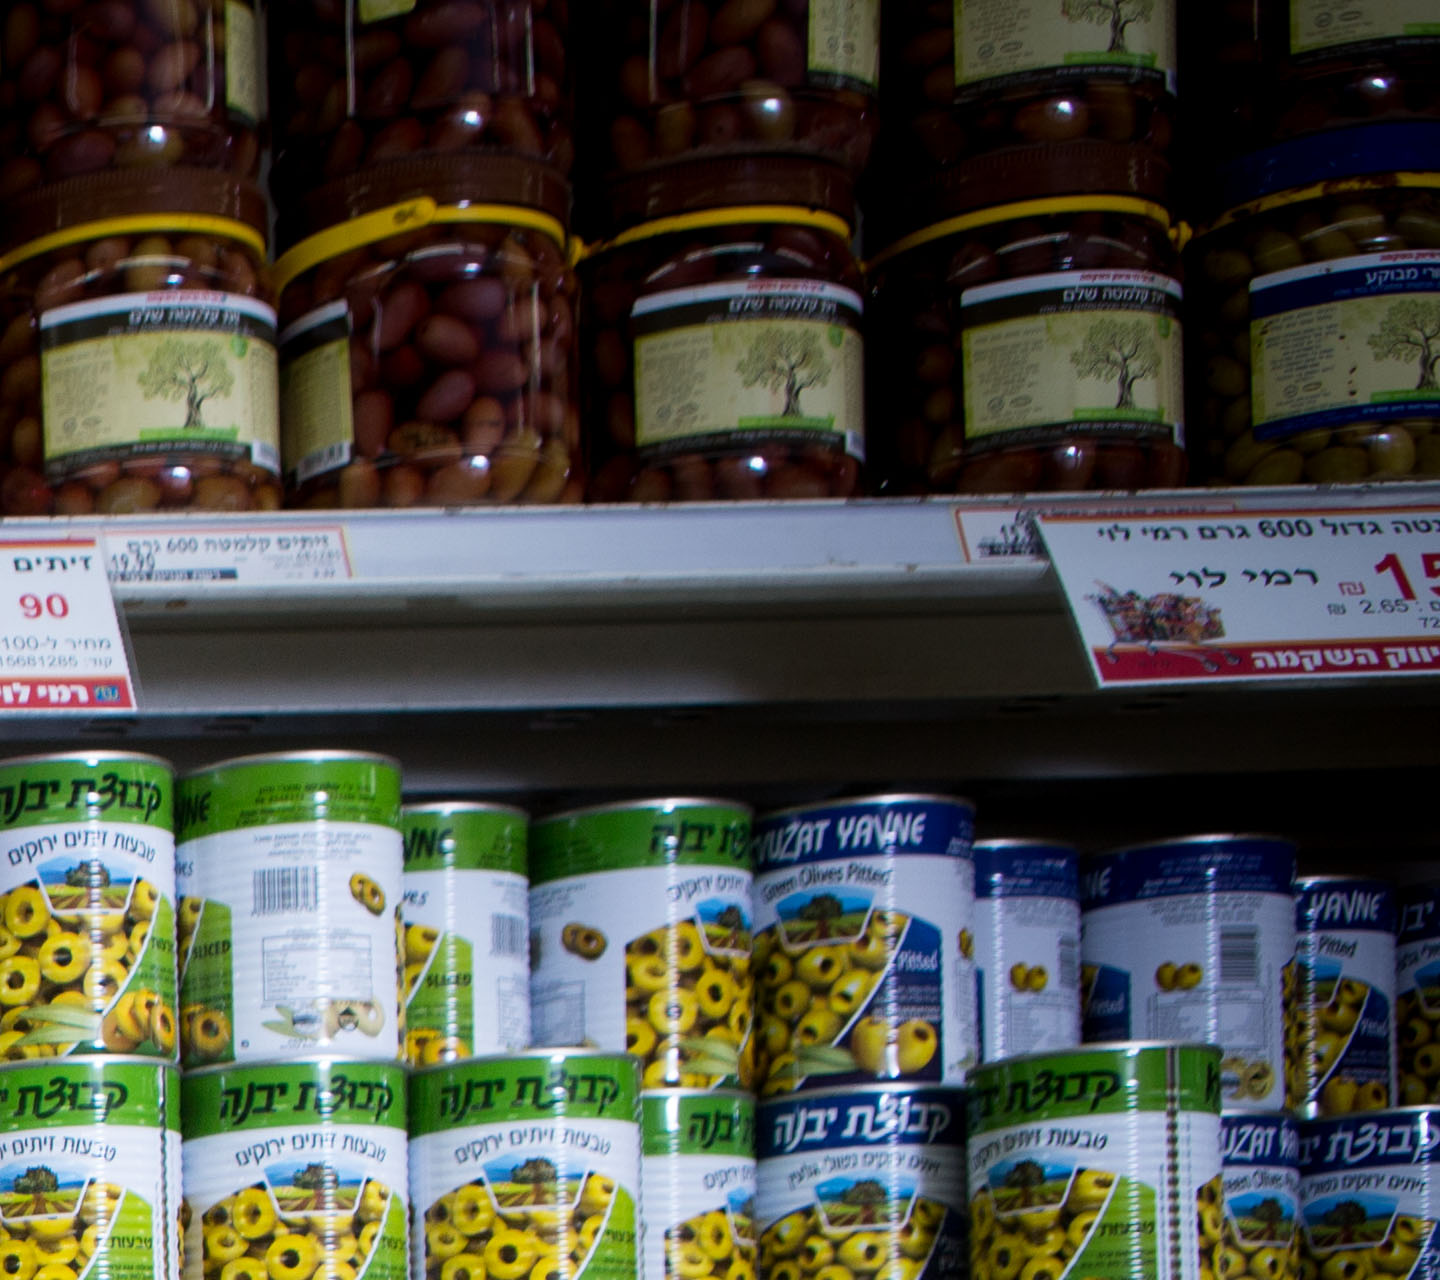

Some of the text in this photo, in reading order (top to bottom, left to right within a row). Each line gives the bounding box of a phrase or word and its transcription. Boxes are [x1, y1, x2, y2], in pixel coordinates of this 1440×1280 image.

[1199, 518, 1382, 539] גדול 600 גרם
[14, 557, 93, 579] זיתים
[20, 593, 71, 619] 90
[38, 681, 89, 704] רמי
[454, 1127, 612, 1165] טבעות זיתים ירוקים
